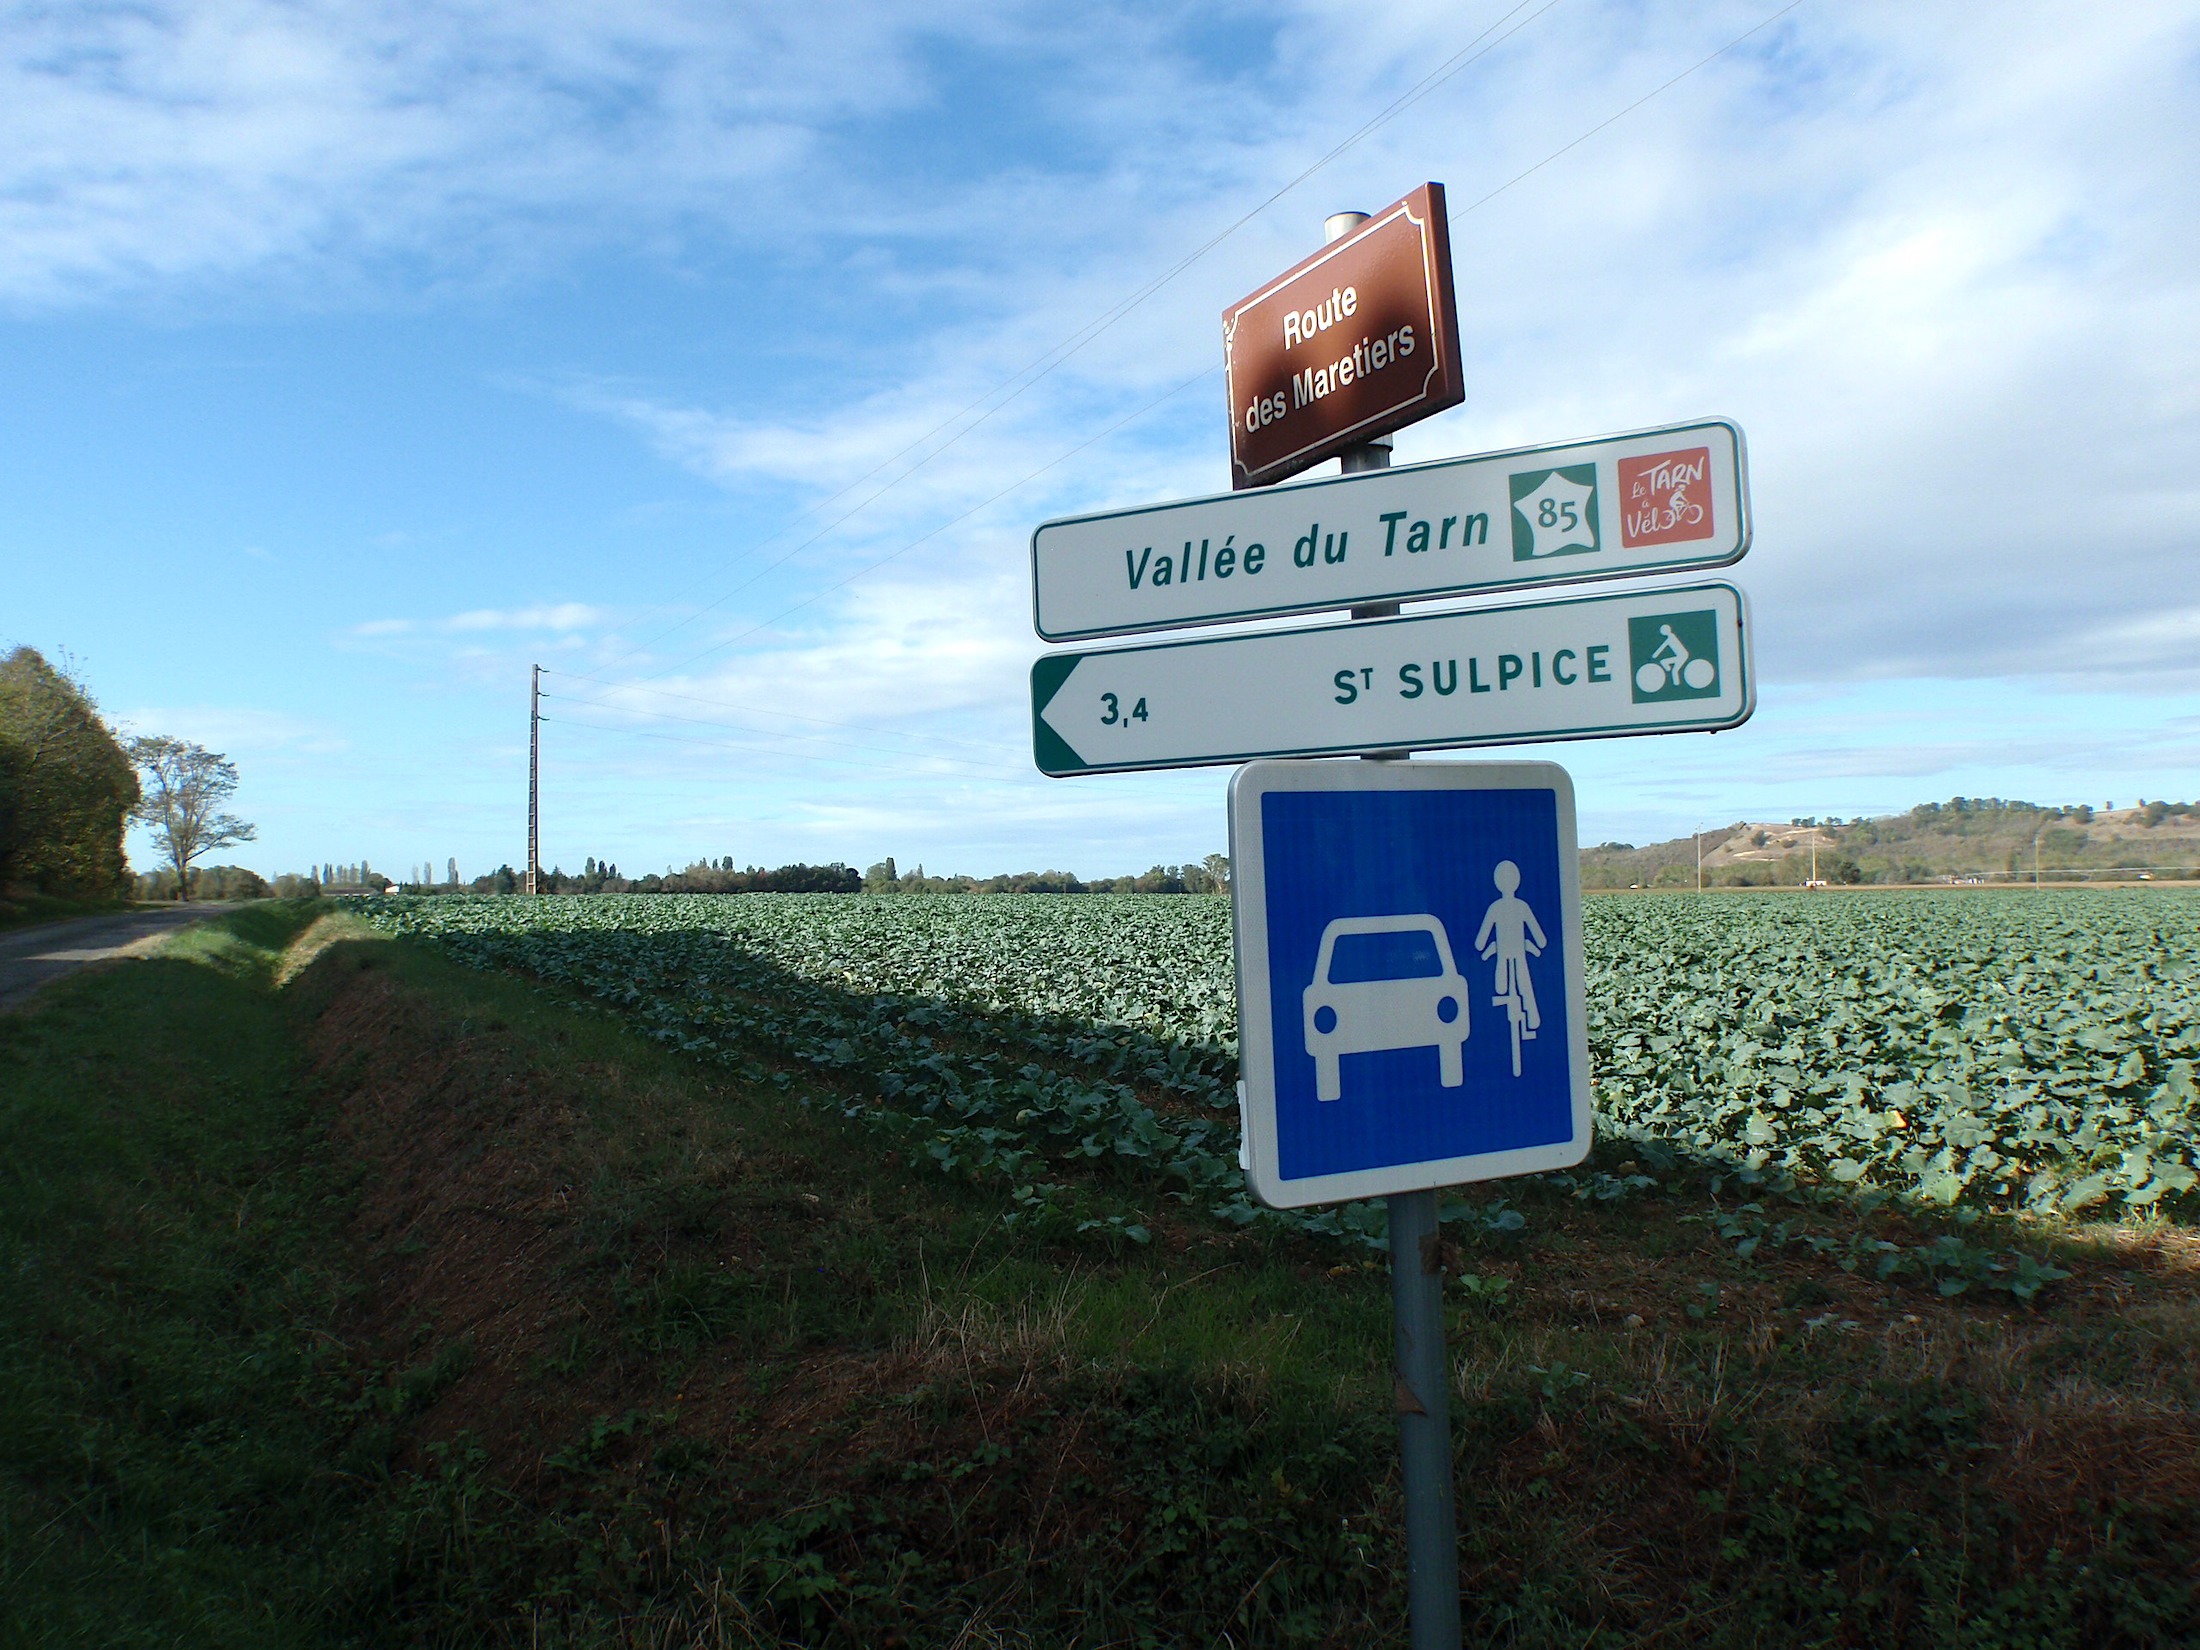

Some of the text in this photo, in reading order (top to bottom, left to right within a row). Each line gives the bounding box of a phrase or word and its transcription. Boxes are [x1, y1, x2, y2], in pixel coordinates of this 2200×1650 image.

[1283, 286, 1358, 350] Route
[1245, 324, 1416, 433] des Maretiers
[1631, 456, 1704, 499] Le TARN
[1537, 498, 1578, 533] 85
[1126, 510, 1489, 590] Vallée du Tarn
[1399, 645, 1612, 700] SULPICE
[1100, 693, 1149, 728] 3,4
